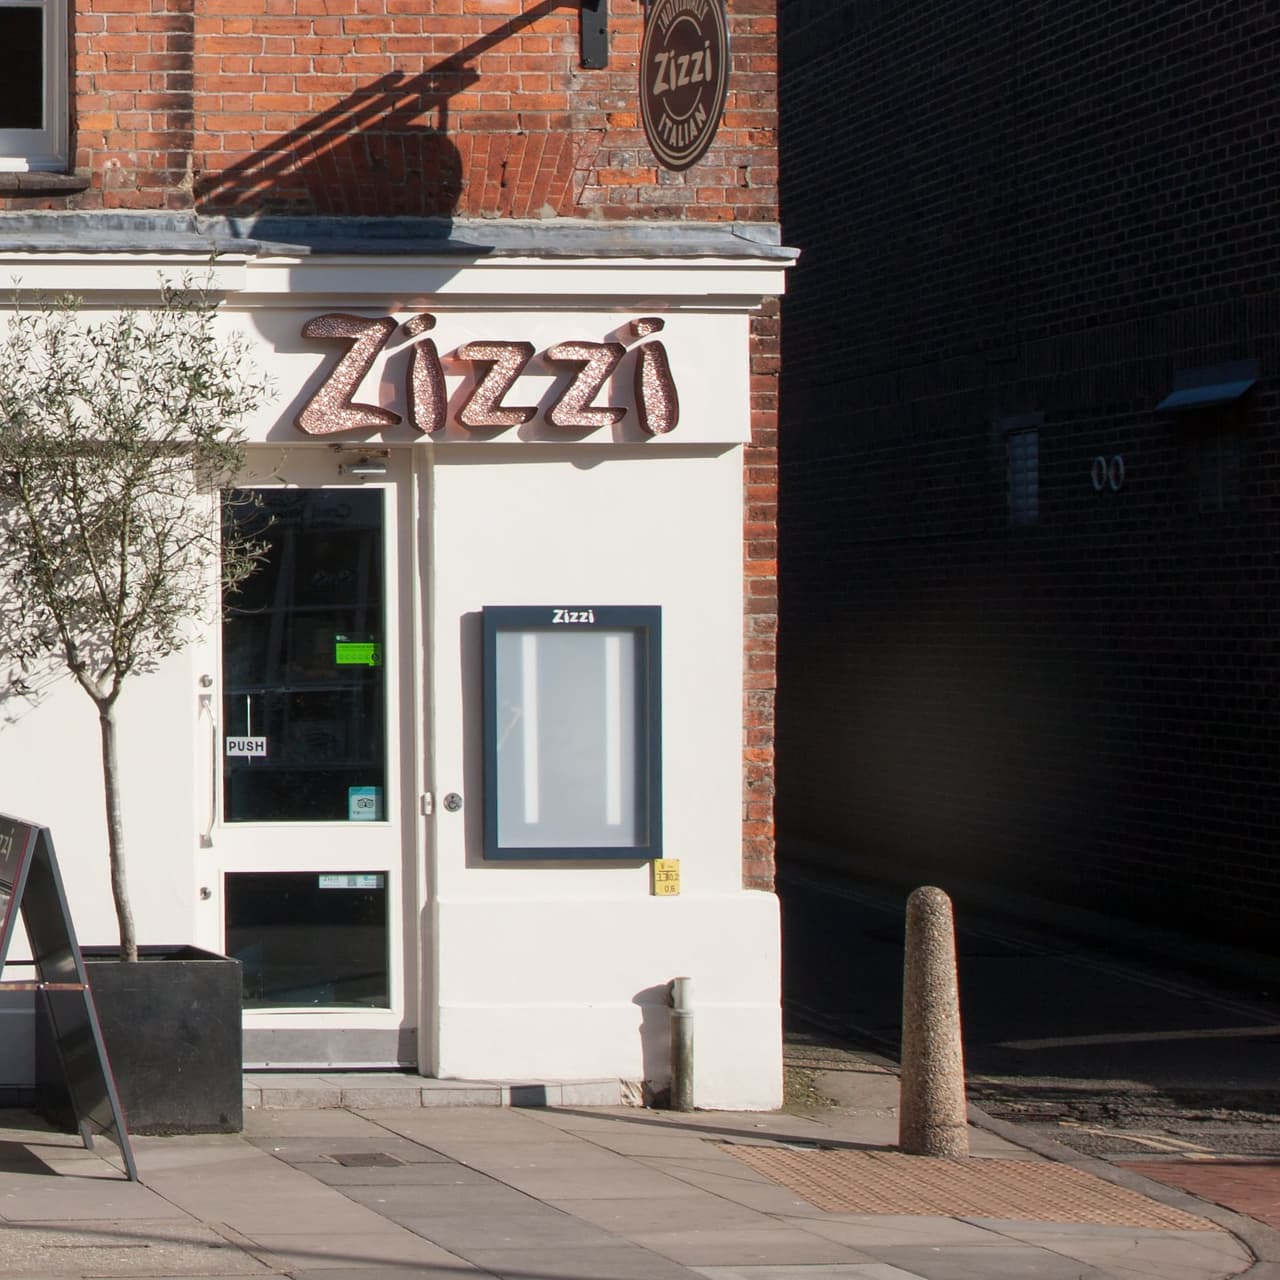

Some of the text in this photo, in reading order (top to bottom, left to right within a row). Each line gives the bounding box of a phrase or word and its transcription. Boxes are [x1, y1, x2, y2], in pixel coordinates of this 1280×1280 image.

[652, 40, 712, 95] Zizzi
[657, 102, 707, 147] ITALIAN
[295, 312, 679, 435] Zizzi
[552, 609, 595, 623] Zizzi
[228, 740, 264, 752] PUSH
